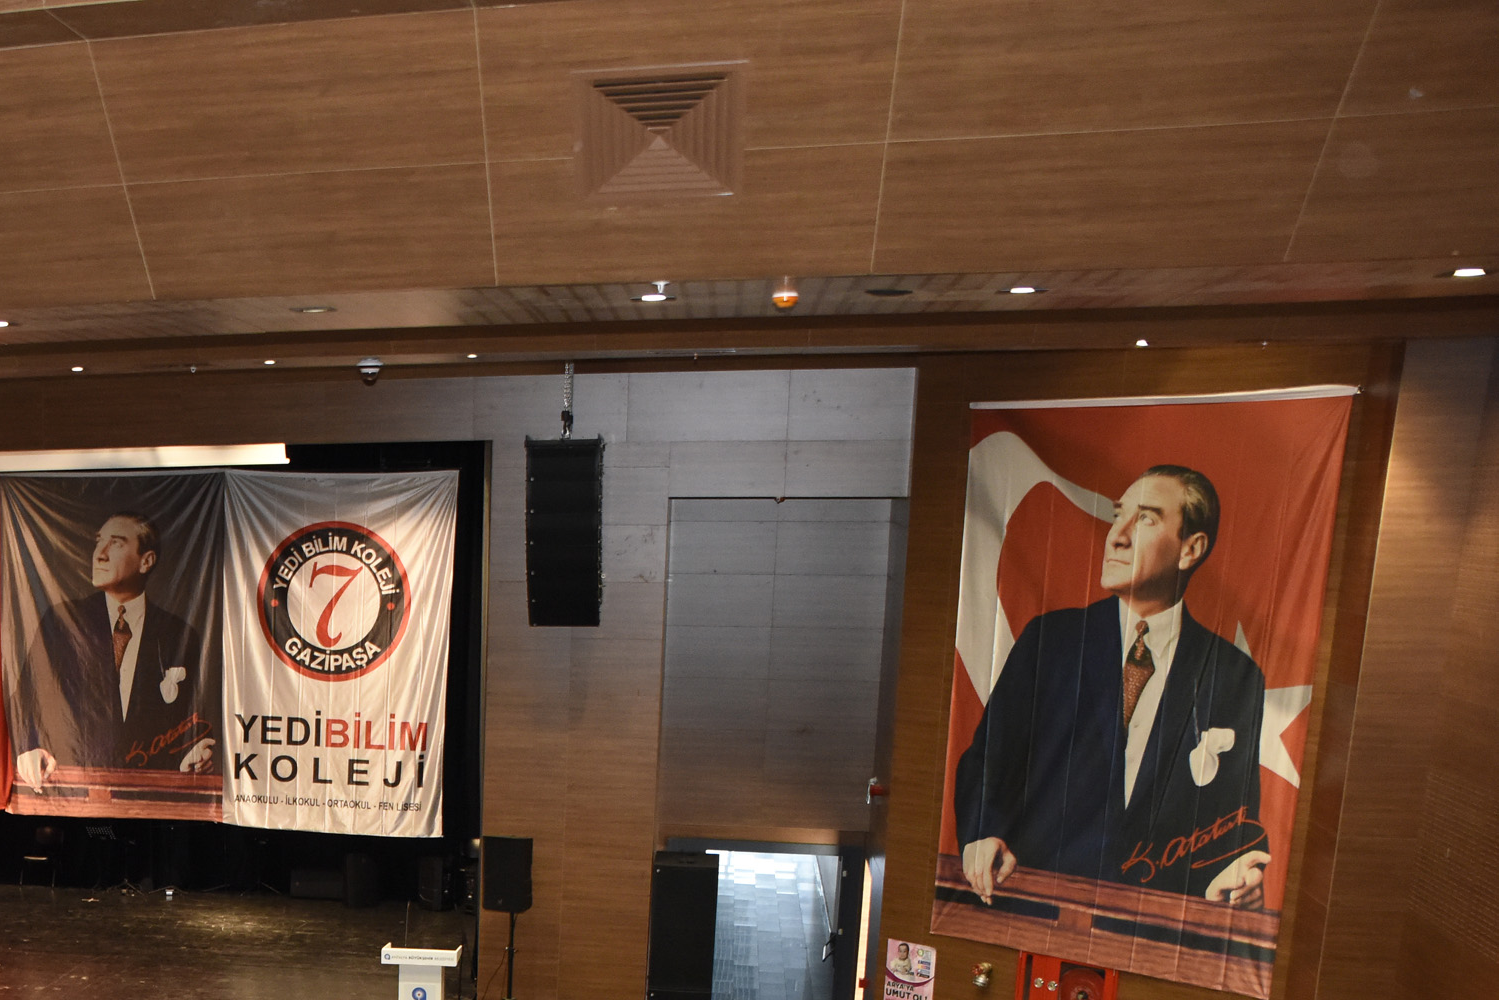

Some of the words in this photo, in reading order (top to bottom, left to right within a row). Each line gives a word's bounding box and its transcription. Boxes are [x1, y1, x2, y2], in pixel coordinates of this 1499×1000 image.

[273, 547, 303, 590] YEDİ
[301, 532, 348, 558] BİLİM
[351, 540, 400, 596] KOLEJİ
[308, 561, 364, 649] 7
[284, 637, 382, 672] GAZİPAŞA
[234, 753, 424, 788] KOLEJİ
[235, 794, 279, 805] ANAOKULU
[285, 794, 321, 807] İLKOKUL
[327, 799, 371, 810] ORTAOKUL
[378, 801, 394, 811] FEN
[886, 988, 910, 1000] UMUT
